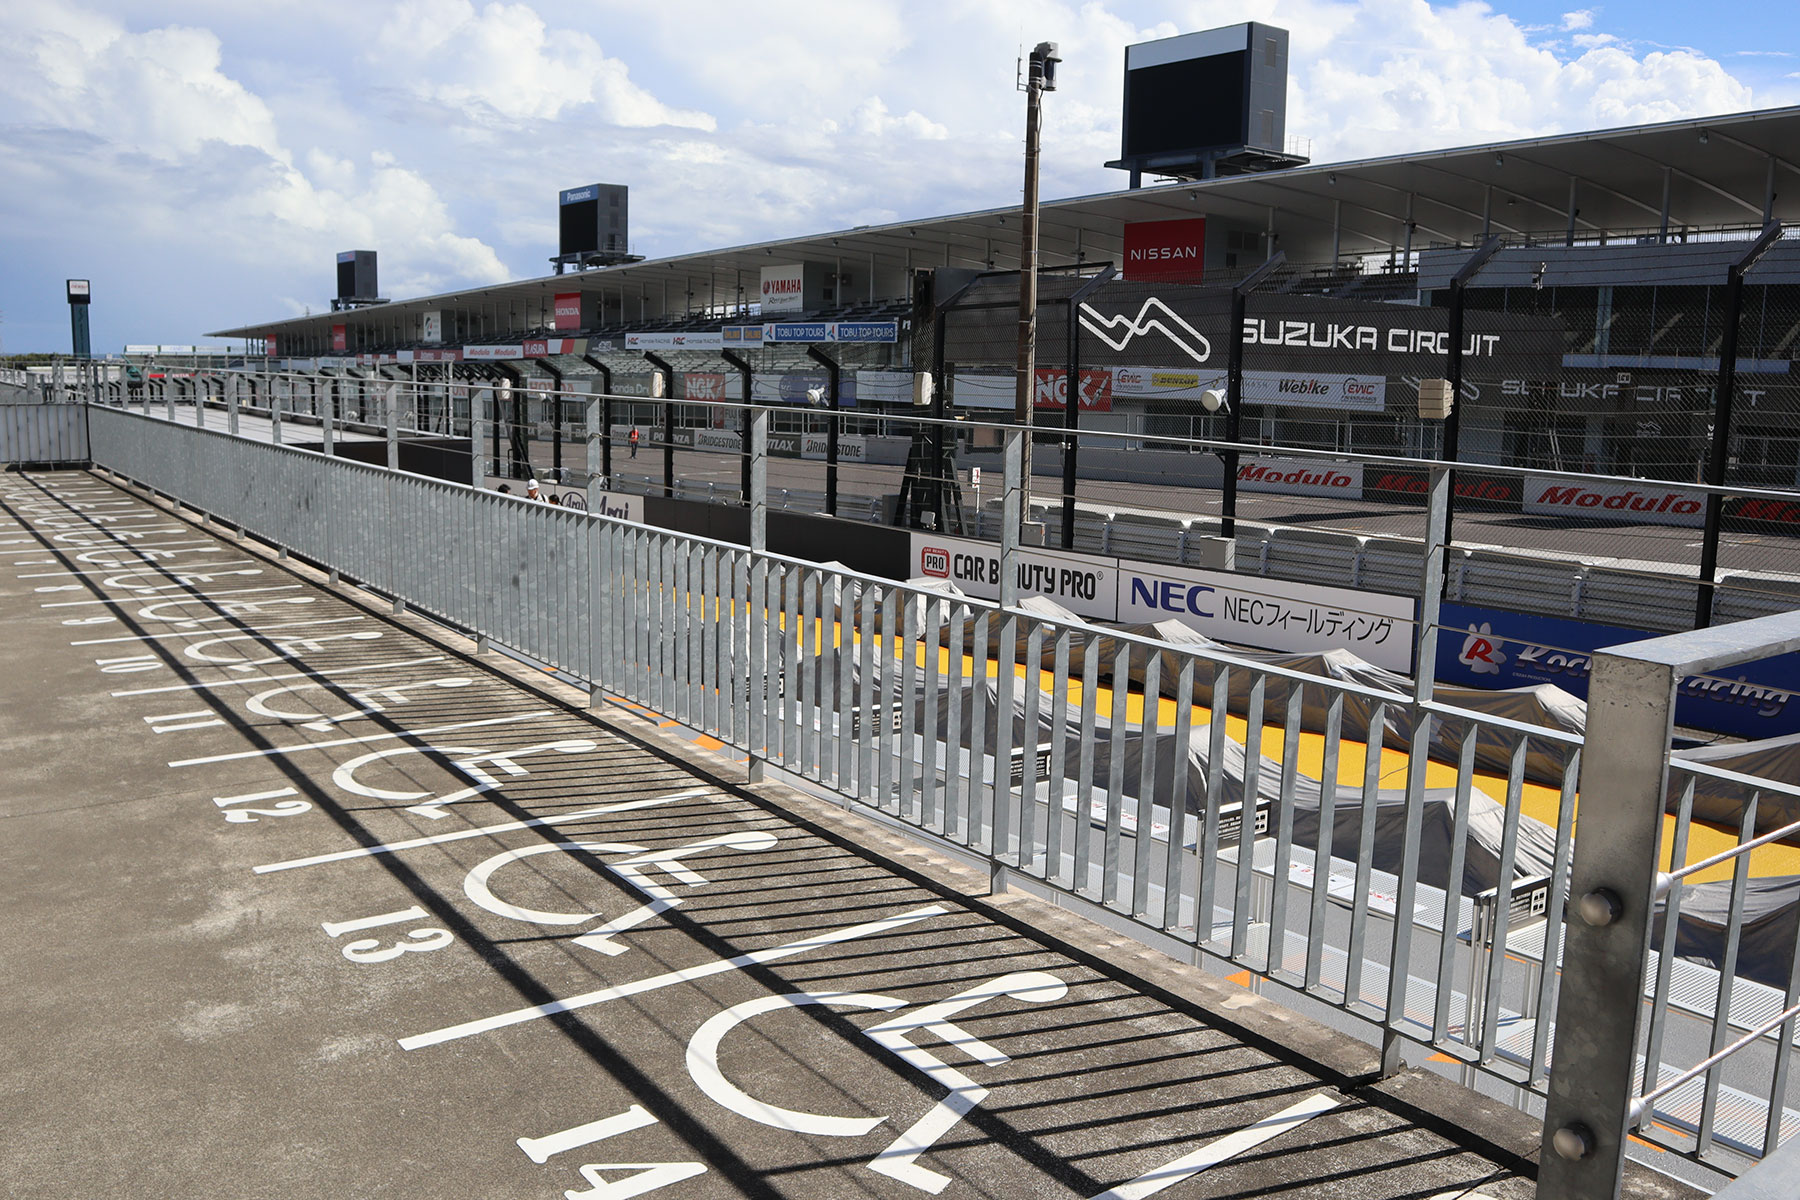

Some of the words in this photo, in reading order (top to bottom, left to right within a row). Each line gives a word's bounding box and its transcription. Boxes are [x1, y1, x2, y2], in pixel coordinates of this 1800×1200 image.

[566, 188, 591, 201] Panasonic
[1130, 246, 1197, 261] NISSAN
[771, 279, 802, 294] YAMAHA
[555, 307, 580, 316] HONDA
[777, 328, 792, 337] TOBU
[793, 328, 805, 337] TOP
[805, 327, 825, 337] TOURS
[840, 328, 857, 338] TOBU
[859, 328, 872, 337] TOP
[1242, 318, 1378, 351] SUZUKA
[686, 378, 715, 399] NGK
[698, 434, 742, 449] BRIDGESTONE
[1237, 464, 1353, 489] Modulo
[1375, 474, 1512, 500] Moulo
[1536, 485, 1702, 516] Modulo
[926, 555, 944, 570] PRO
[953, 553, 985, 583] CAR
[1131, 577, 1215, 618] NEC
[61, 616, 117, 626] 9
[1224, 596, 1394, 645] NECフィールディング
[95, 654, 164, 674] 10
[143, 709, 227, 734] 11
[212, 787, 313, 823] 12
[321, 905, 455, 963] 13
[516, 1103, 708, 1200] 14
